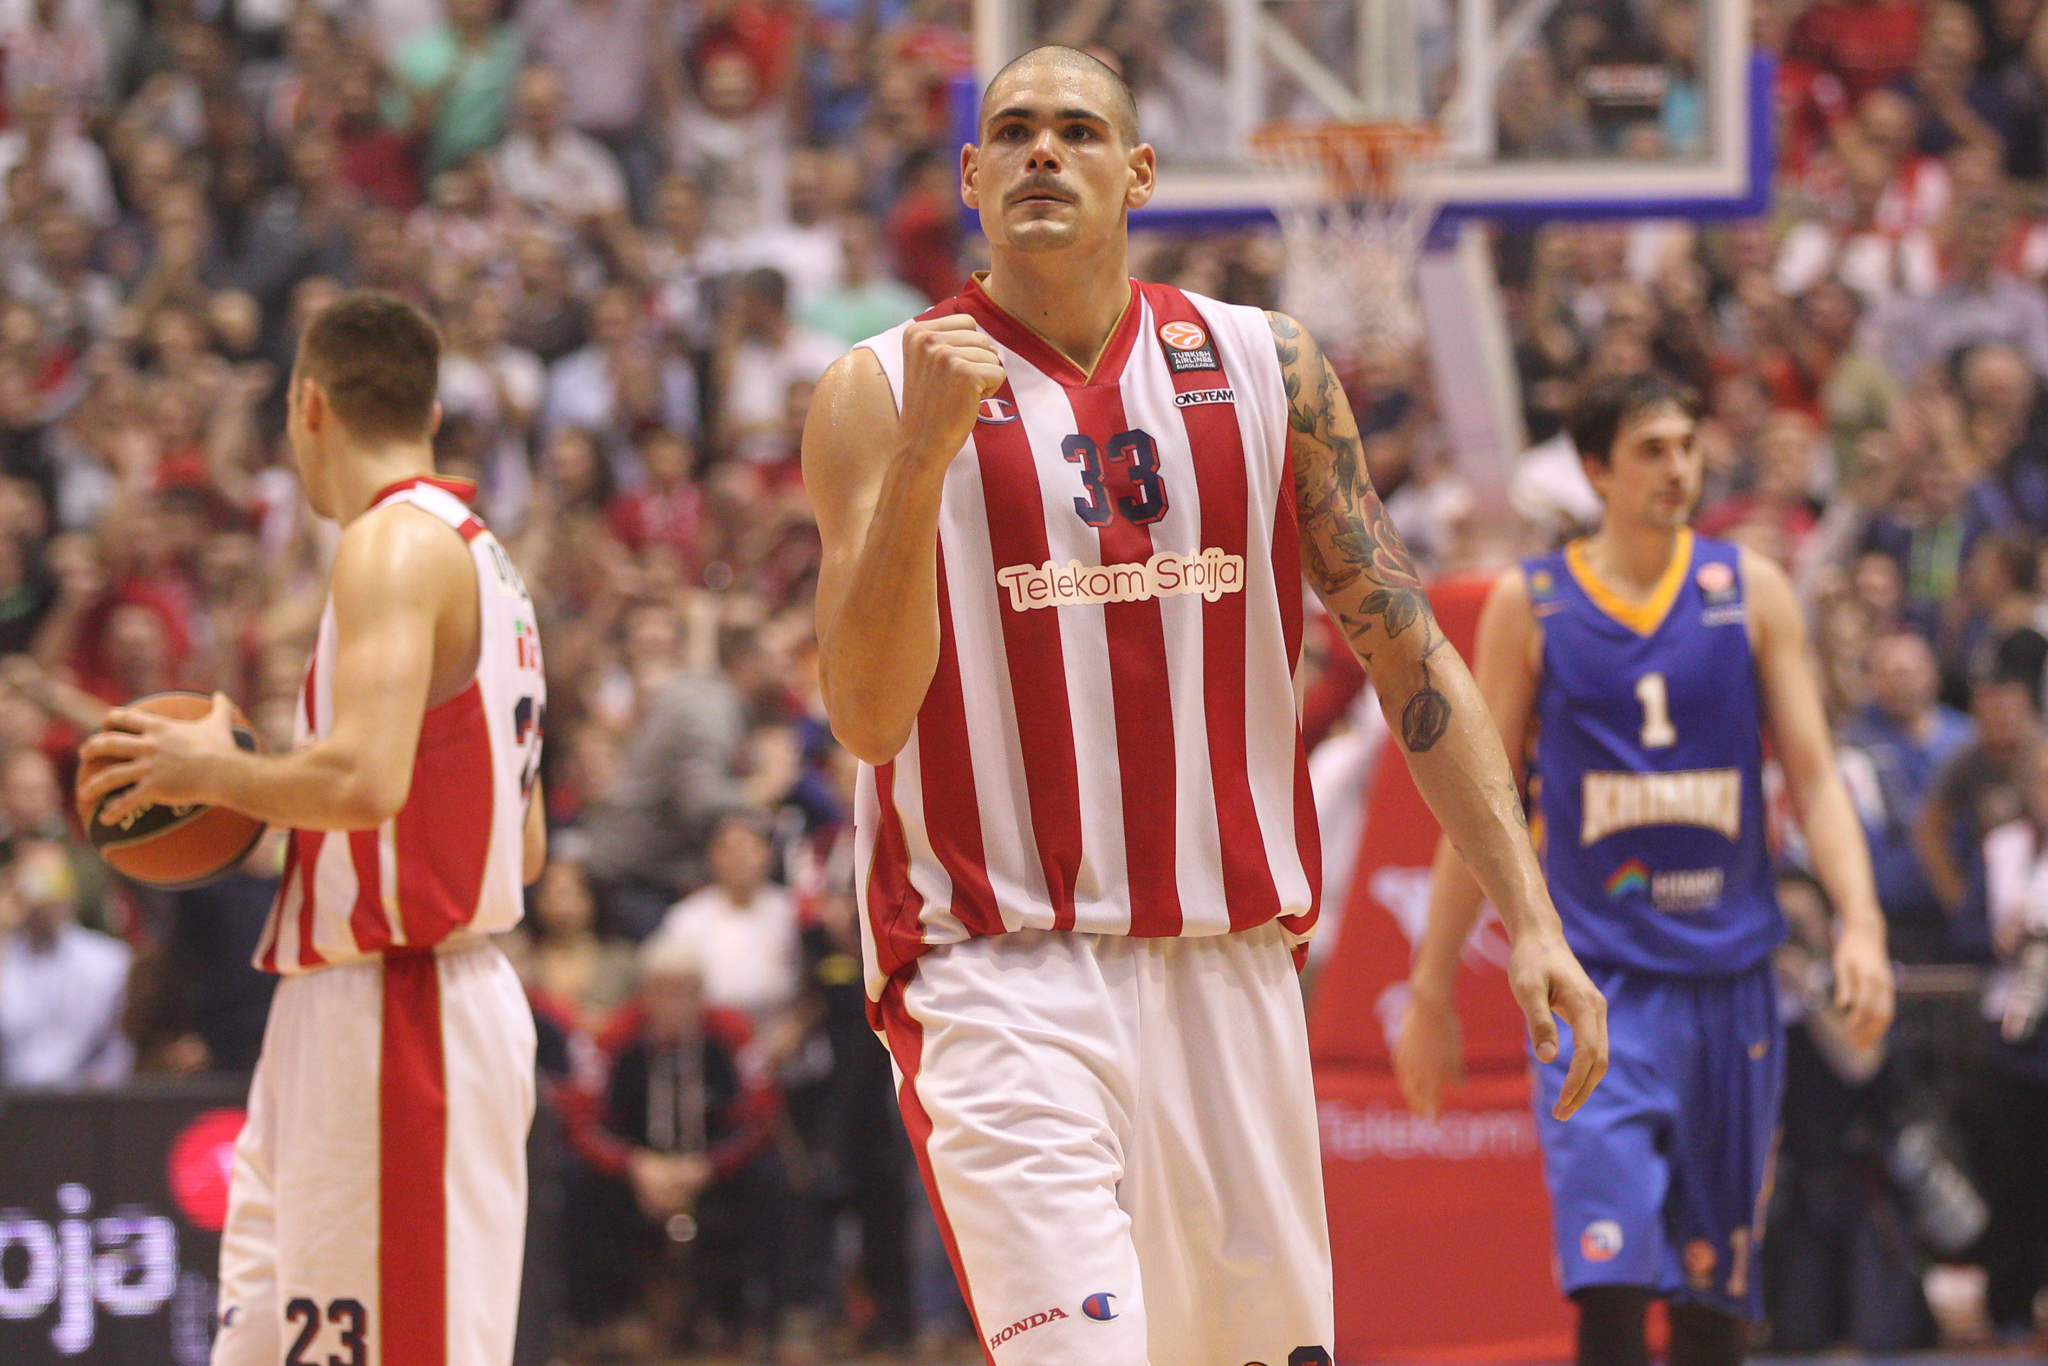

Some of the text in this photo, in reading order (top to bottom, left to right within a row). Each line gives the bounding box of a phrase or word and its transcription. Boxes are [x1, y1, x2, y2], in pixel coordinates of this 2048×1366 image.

[1171, 350, 1211, 358] TURKISH
[1175, 356, 1213, 365] AIRLINES
[1176, 362, 1216, 370] EUROLEAGUE
[1061, 429, 1169, 528] 33
[1005, 554, 1238, 604] Telekom Srbija
[1634, 671, 1678, 748] 1
[285, 1296, 368, 1366] 23
[989, 1306, 1069, 1351] HONDA
